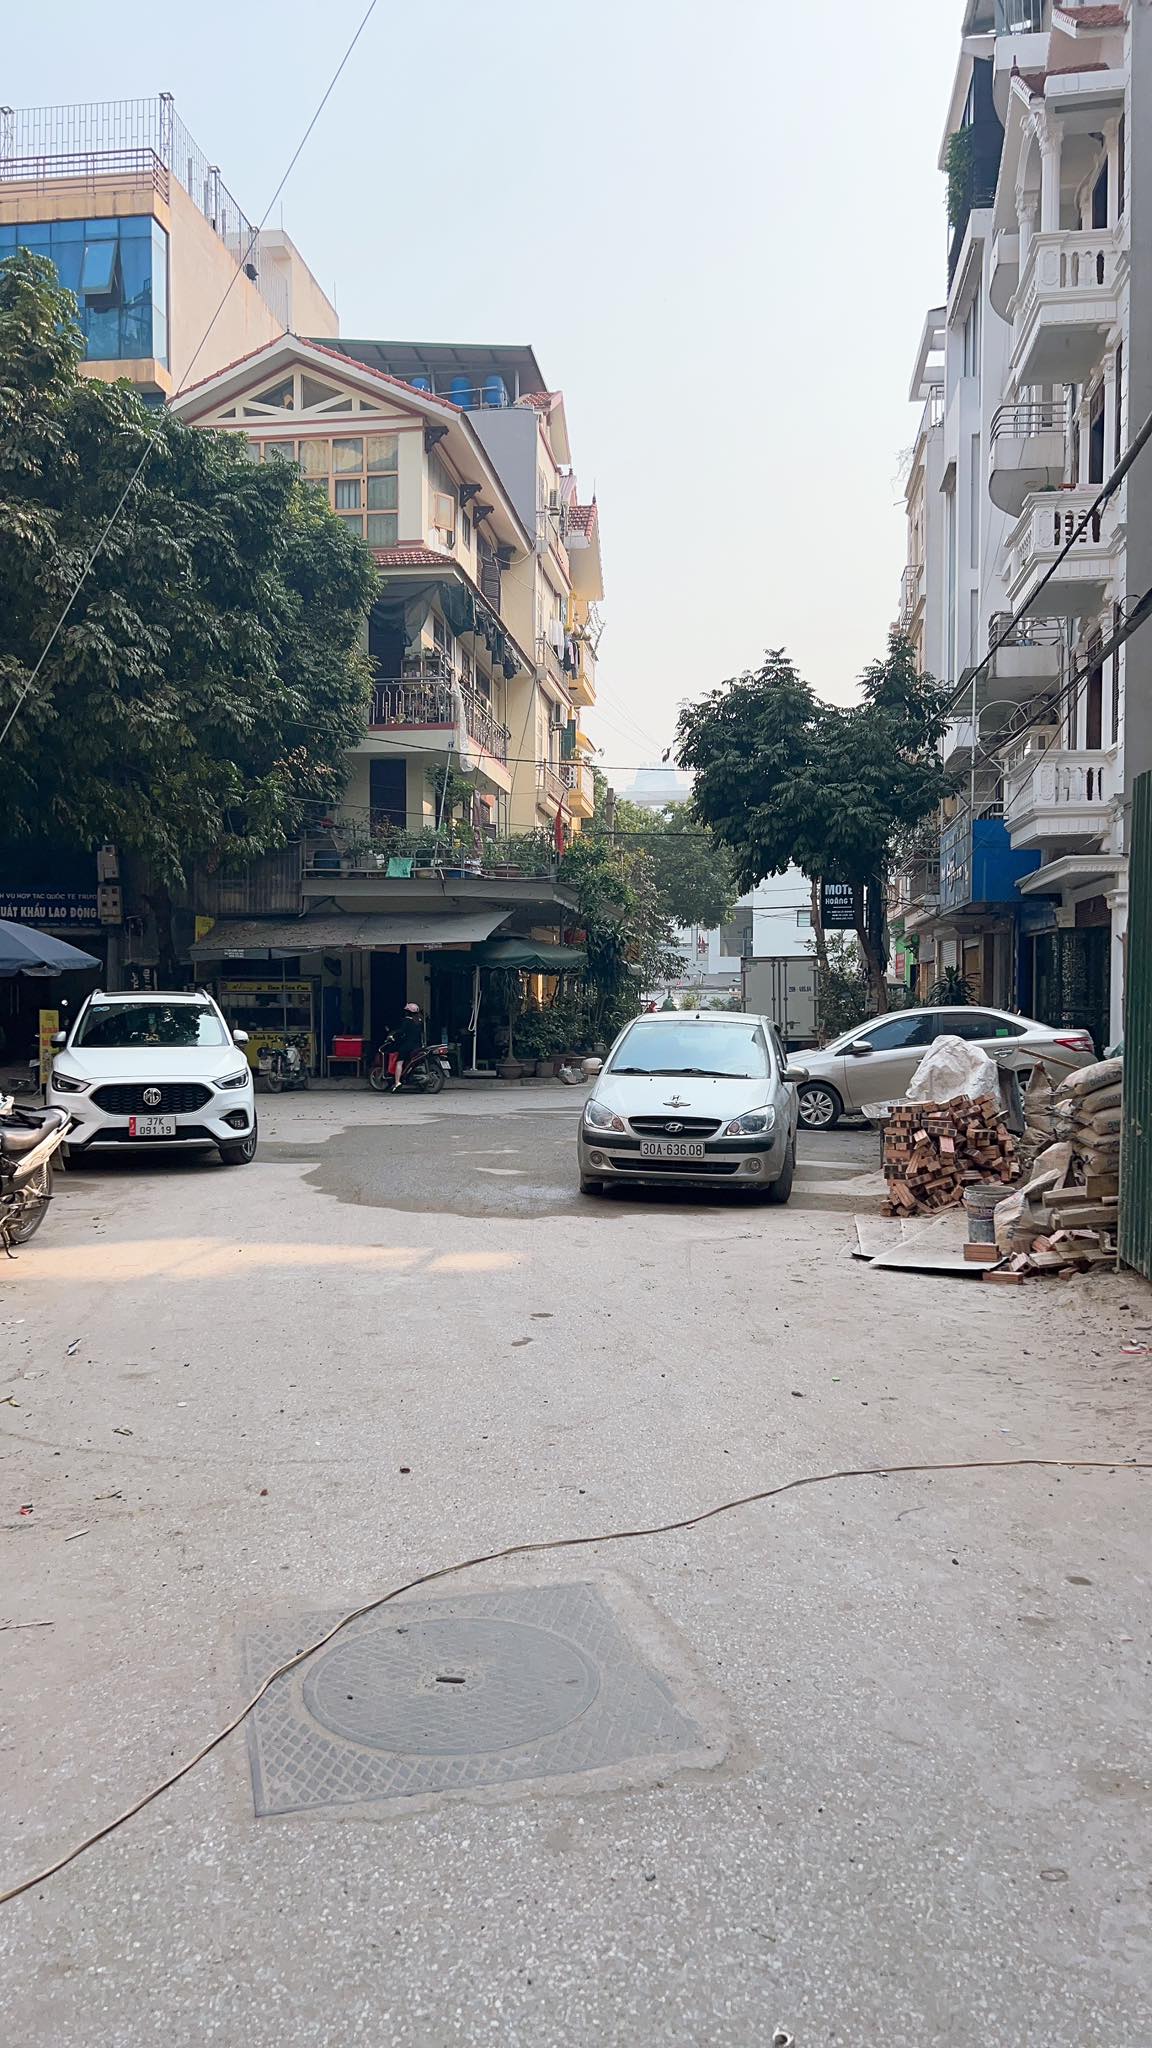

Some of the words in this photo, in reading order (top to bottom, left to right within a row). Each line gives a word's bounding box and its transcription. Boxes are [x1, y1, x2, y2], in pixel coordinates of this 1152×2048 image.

[48, 906, 67, 918] LAO
[70, 905, 97, 921] ĐỘNG
[143, 1088, 161, 1105] MG
[147, 1117, 164, 1126] 37K
[140, 1126, 172, 1135] 091.19
